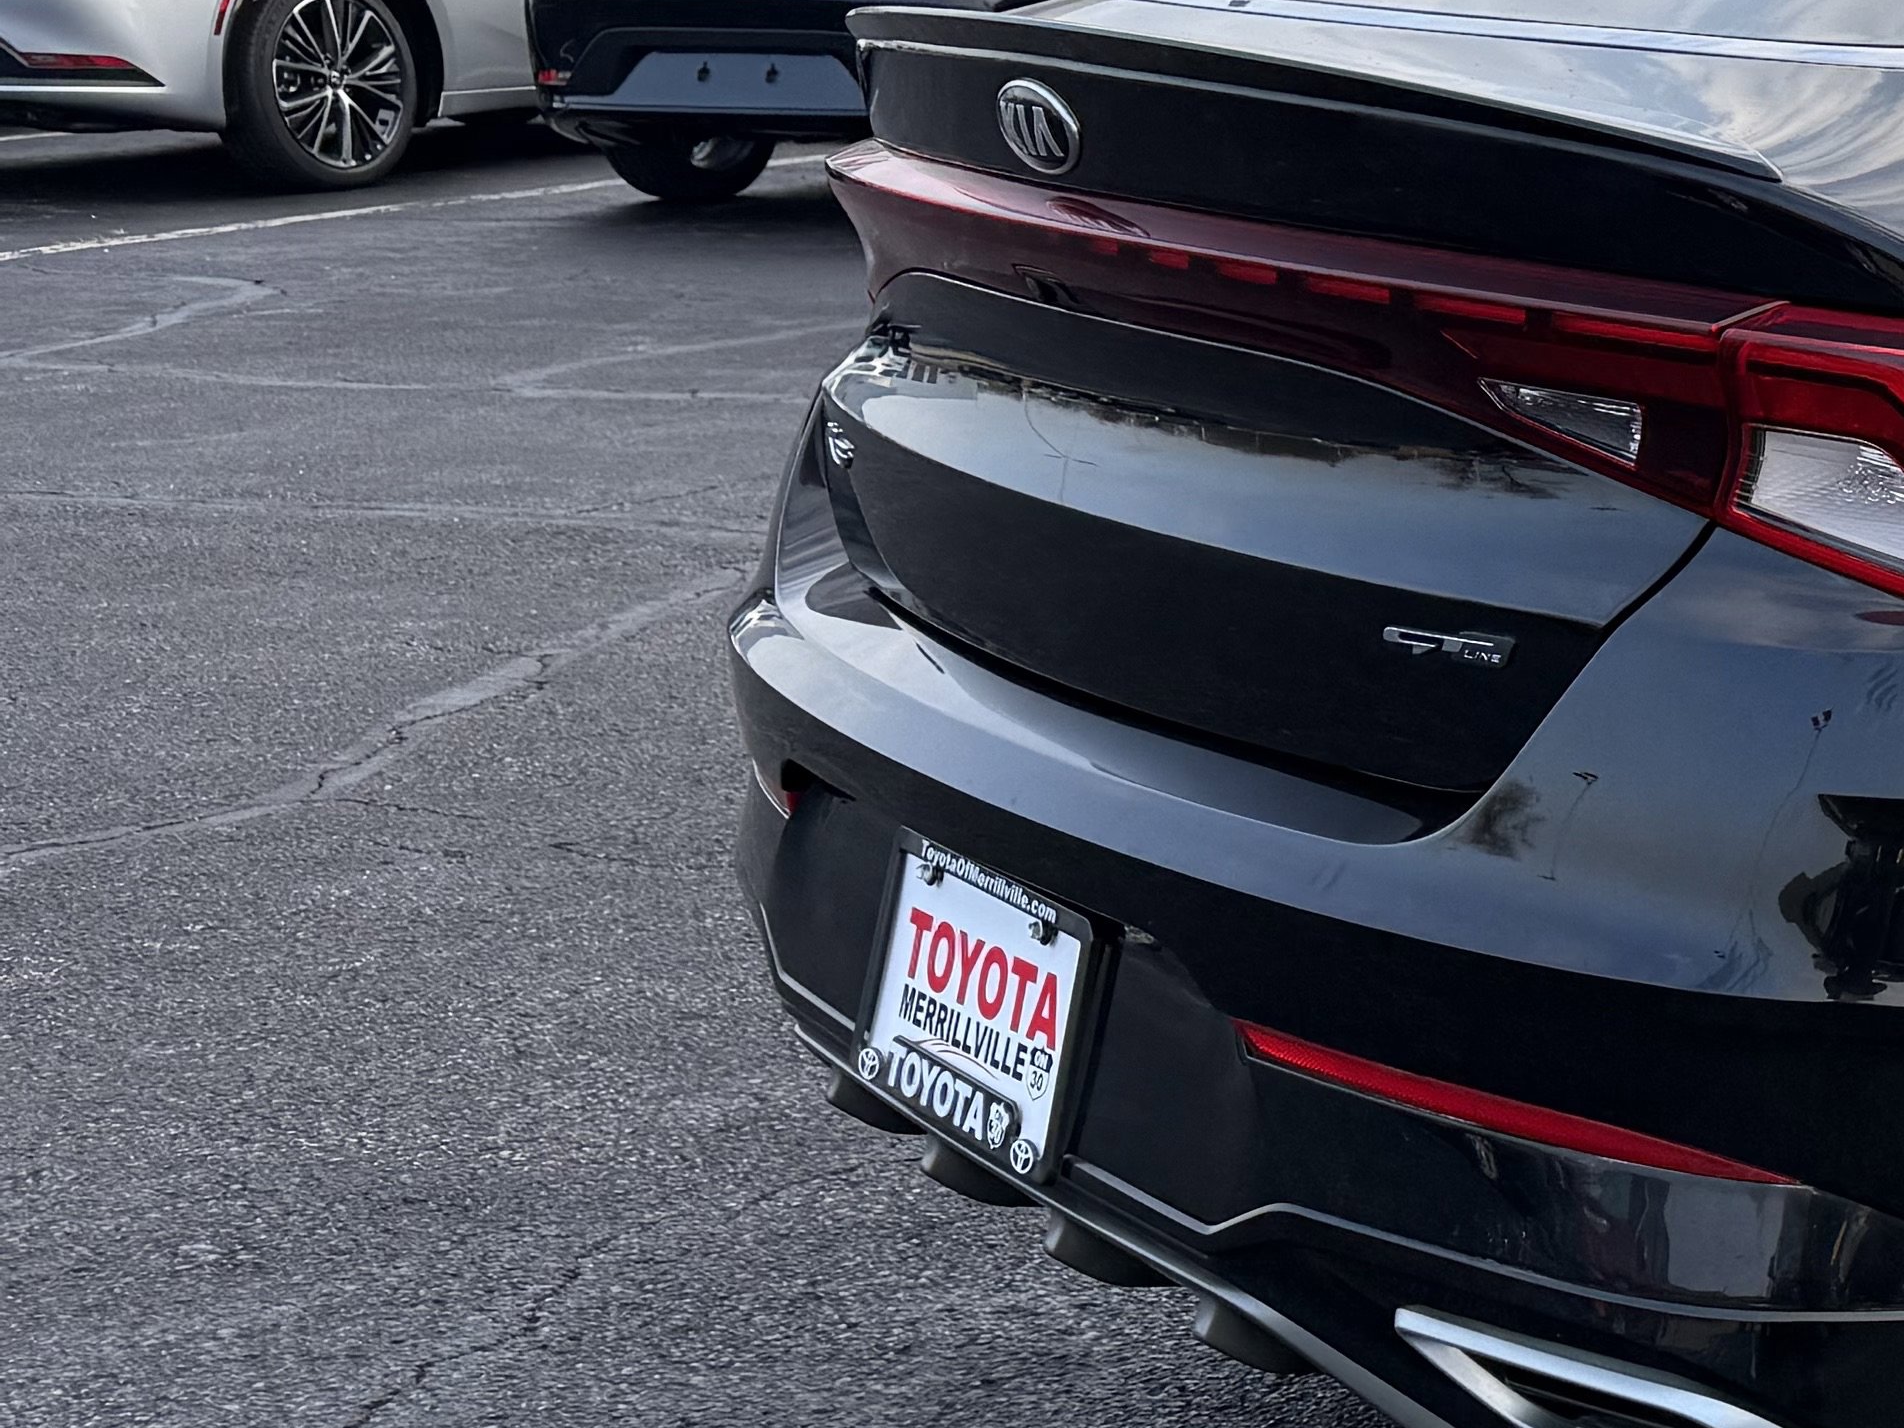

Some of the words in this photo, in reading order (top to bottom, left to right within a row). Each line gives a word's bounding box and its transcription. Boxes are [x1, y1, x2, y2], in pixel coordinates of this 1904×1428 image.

[1000, 100, 1064, 157] KIA
[1464, 649, 1502, 664] LINE
[921, 839, 1057, 923] ToyotaOfMerrillville.com
[909, 907, 1058, 1051] TOYOTA
[899, 983, 1028, 1082] MERRILLVILLE
[887, 1042, 985, 1142] TOYOTA
[1029, 1069, 1044, 1093] 30
